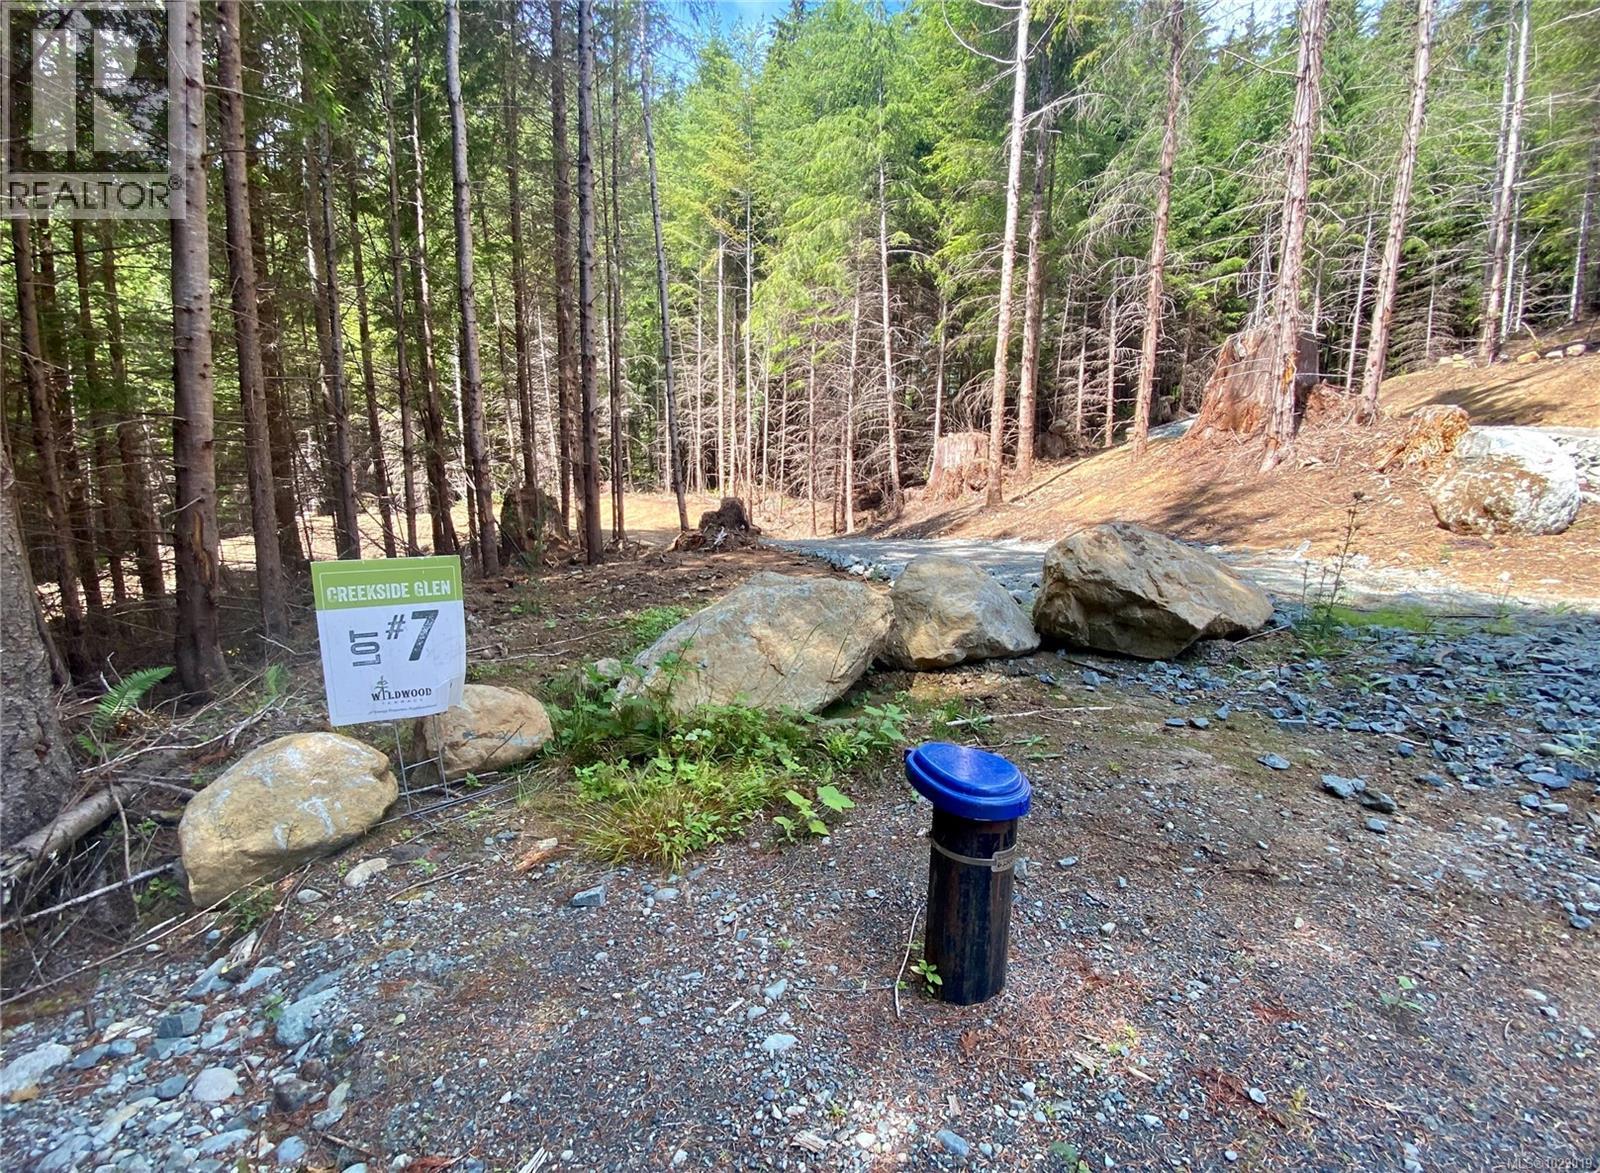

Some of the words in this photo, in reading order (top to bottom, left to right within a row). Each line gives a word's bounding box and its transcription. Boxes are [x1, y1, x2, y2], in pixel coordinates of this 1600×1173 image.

[326, 583, 410, 603] CREEKSIDE
[414, 580, 451, 596] GLEN
[349, 630, 381, 667] LOT
[371, 685, 432, 701] WILDWOOD
